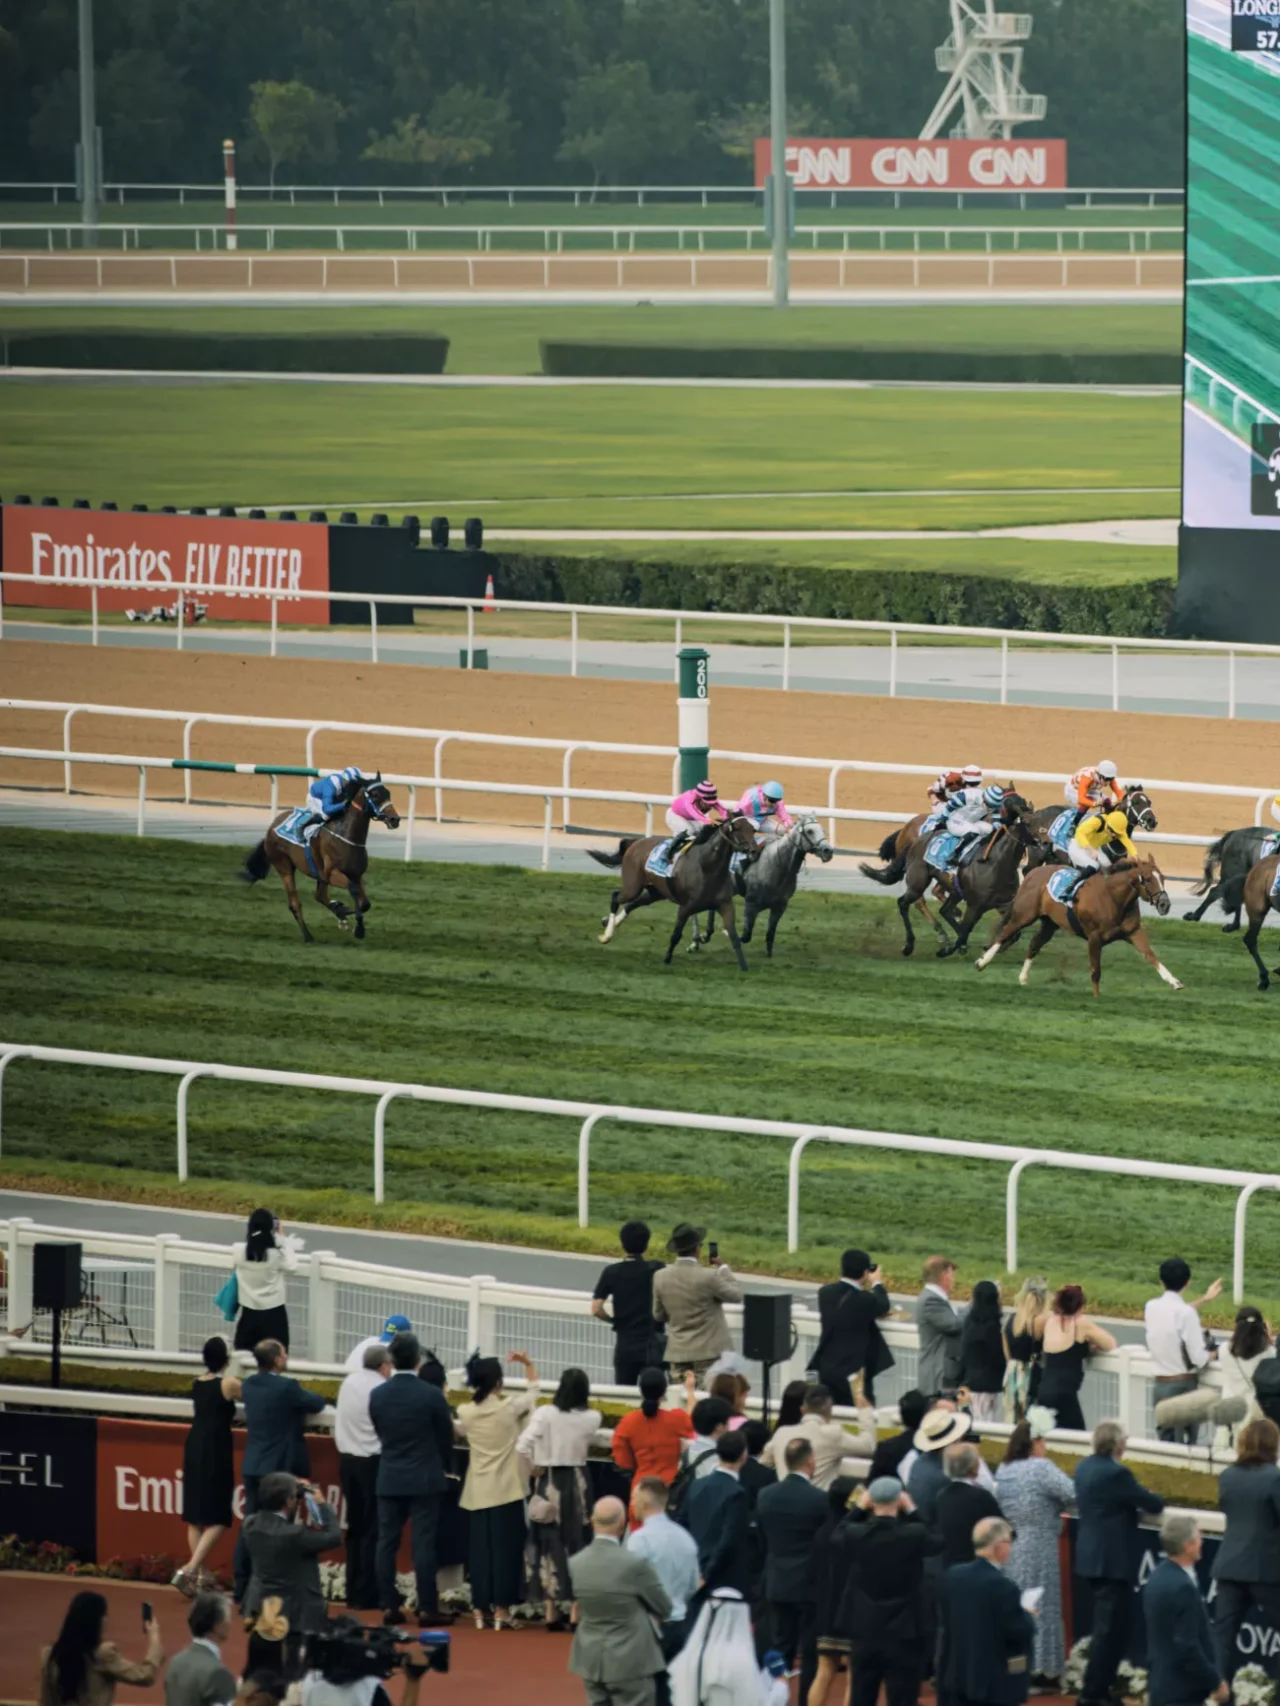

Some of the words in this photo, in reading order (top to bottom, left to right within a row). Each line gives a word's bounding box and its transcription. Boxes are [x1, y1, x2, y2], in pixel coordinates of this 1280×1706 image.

[785, 147, 850, 184] CNN
[871, 147, 949, 184] CNN
[969, 147, 1046, 185] CNN
[31, 532, 172, 591] Emirates
[184, 542, 221, 595] FLY
[225, 545, 302, 601] BETTER
[696, 659, 706, 698] 200
